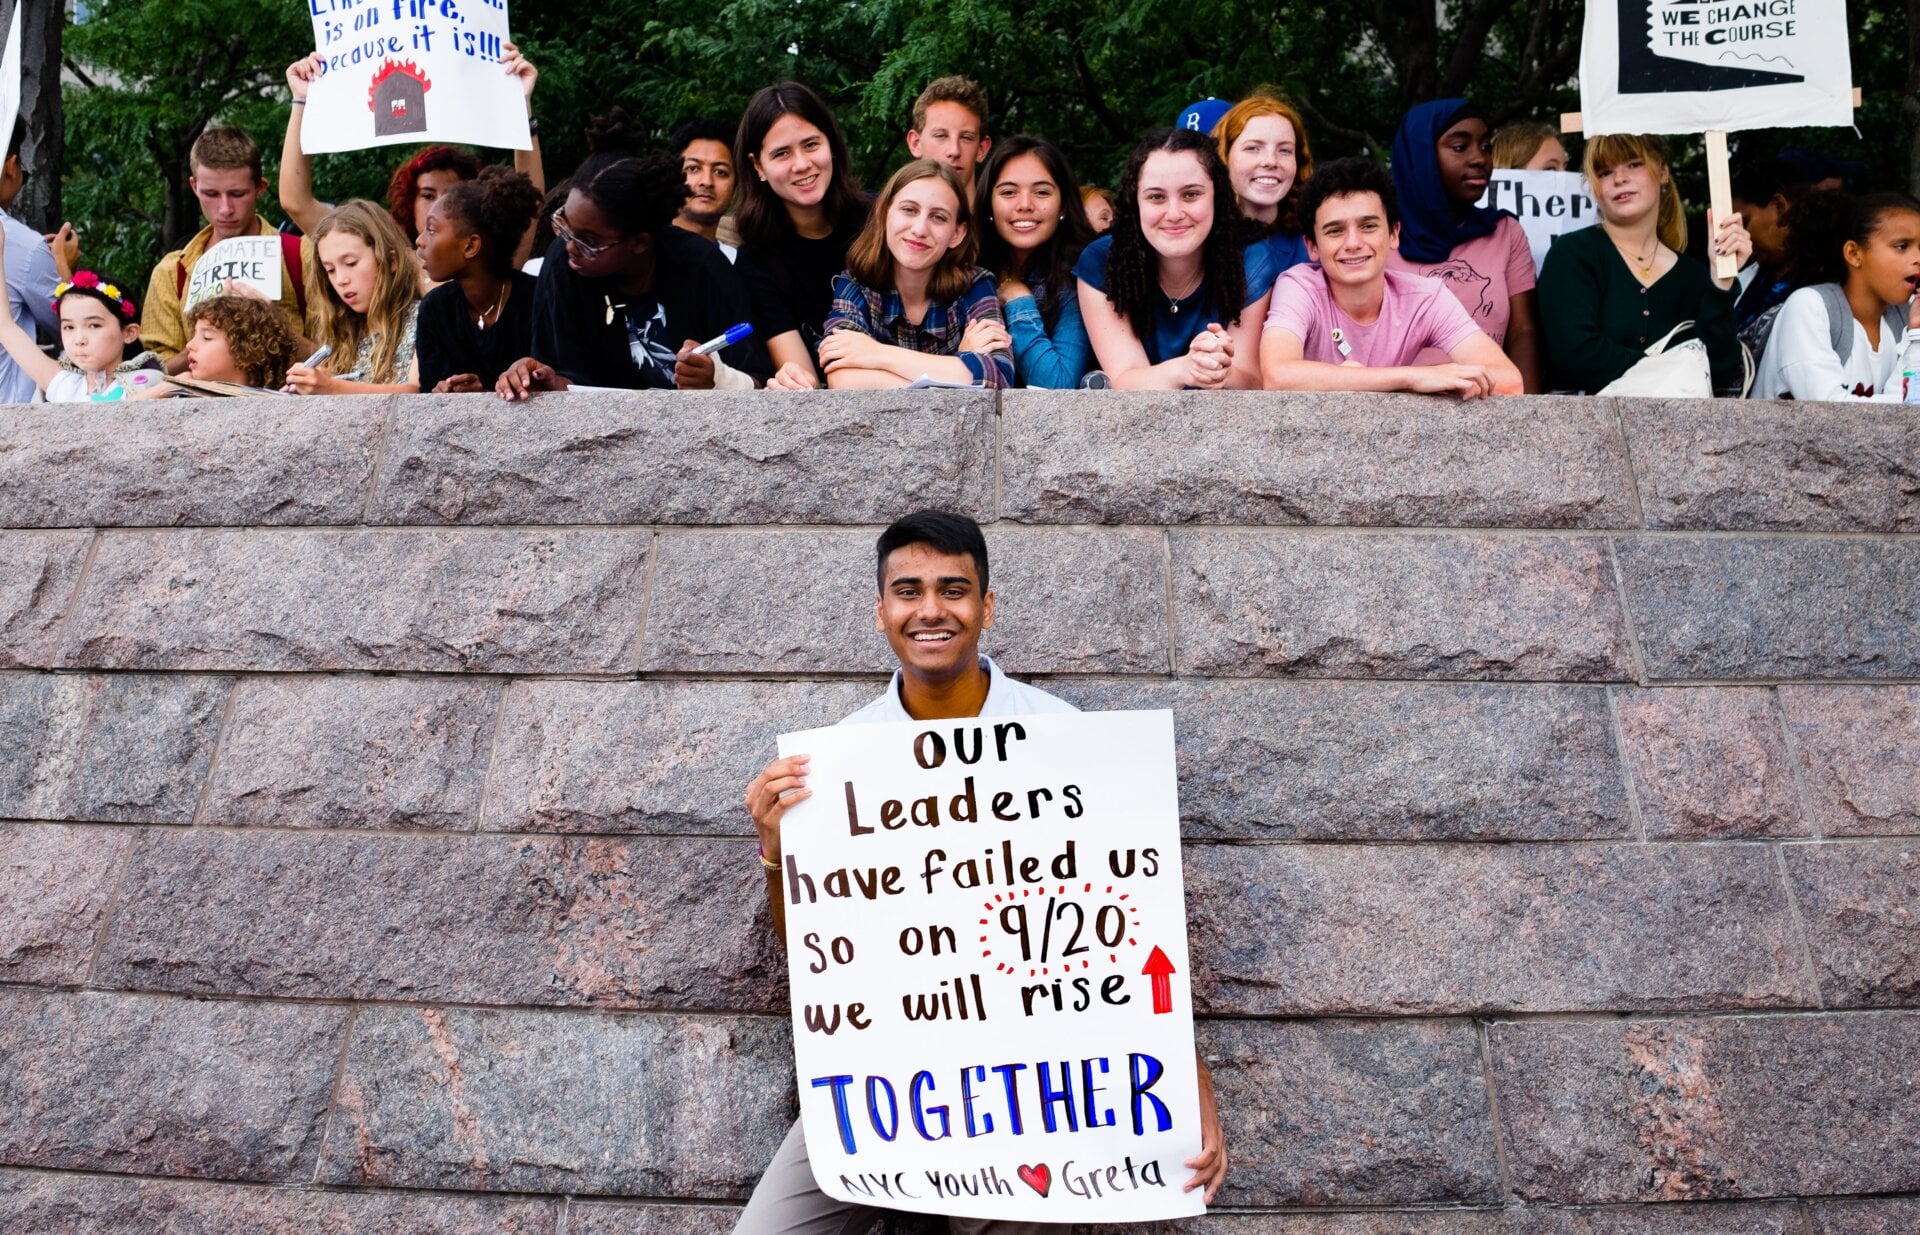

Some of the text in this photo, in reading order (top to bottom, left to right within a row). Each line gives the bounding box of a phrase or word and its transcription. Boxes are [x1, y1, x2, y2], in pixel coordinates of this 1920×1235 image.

[325, 21, 343, 46] is
[354, 8, 379, 31] on
[1662, 0, 1796, 26] WE CHANGE
[1662, 20, 1796, 47] THE COURSE
[413, 25, 435, 52] it
[453, 27, 501, 64] is!!!
[1487, 179, 1601, 219] Ther
[190, 261, 266, 296] STRIKE
[196, 240, 277, 275] CLIMATE
[914, 722, 1027, 770] our
[845, 776, 1084, 837] Leaders
[785, 840, 1160, 905] have failed us
[898, 924, 957, 957] on
[999, 896, 1127, 964] 9/20
[803, 974, 1131, 1036] we will rise
[811, 1053, 1173, 1156] TOGETHER
[839, 1171, 921, 1199] NYC
[1062, 1156, 1167, 1200] Greta
